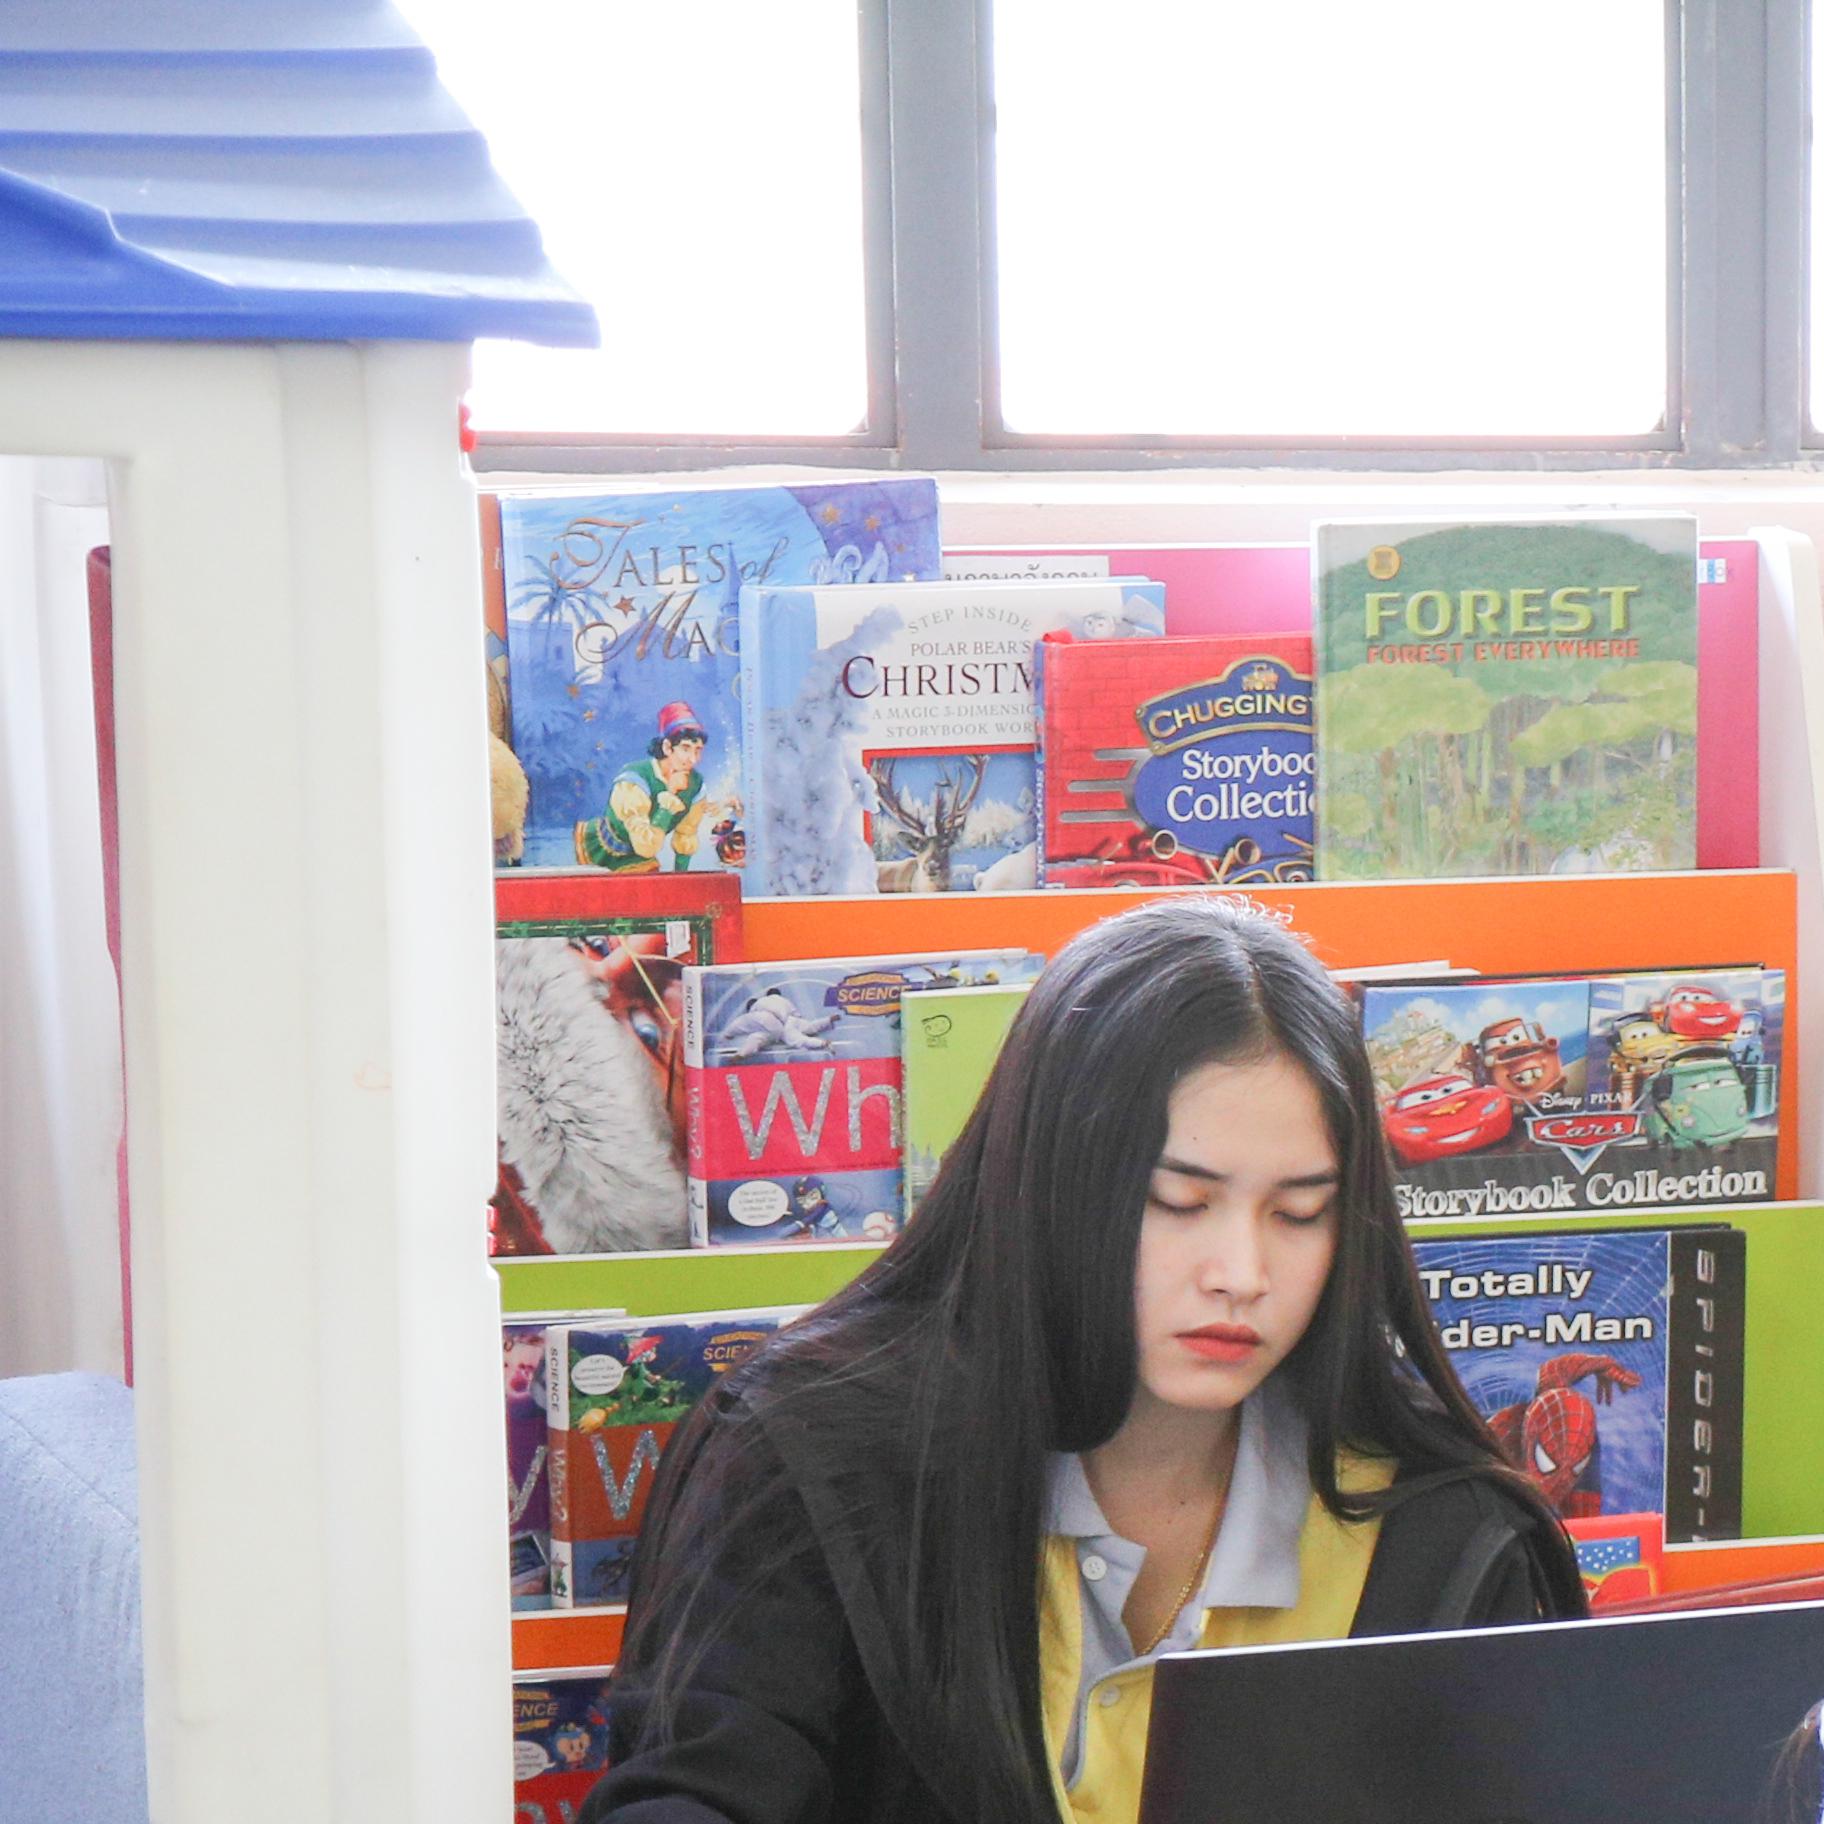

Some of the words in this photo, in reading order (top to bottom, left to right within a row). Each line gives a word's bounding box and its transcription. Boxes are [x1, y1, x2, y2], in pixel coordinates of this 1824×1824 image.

[550, 517, 727, 590] TALES
[908, 608, 954, 634] STEP
[964, 606, 1032, 633] INSIDE
[1365, 585, 1640, 639] FOREST
[911, 642, 967, 657] POLAR
[973, 640, 1031, 655] BEAR'S
[1367, 643, 1464, 665] FOREST
[1473, 638, 1641, 662] EVERYWHERE
[886, 722, 988, 739] STORYBOOK
[995, 720, 1036, 736] WOR
[1148, 693, 1315, 739] CHUGGING
[685, 985, 696, 1049] SCIENCE
[1590, 1090, 1634, 1105] PIXAR
[1540, 1117, 1626, 1140] Cars
[1395, 1176, 1576, 1219] Storybook
[1586, 1167, 1767, 1205] Collection
[1420, 1264, 1593, 1299] Totally
[1441, 1312, 1653, 1349] der-Man
[549, 1347, 560, 1413] SCIENCE
